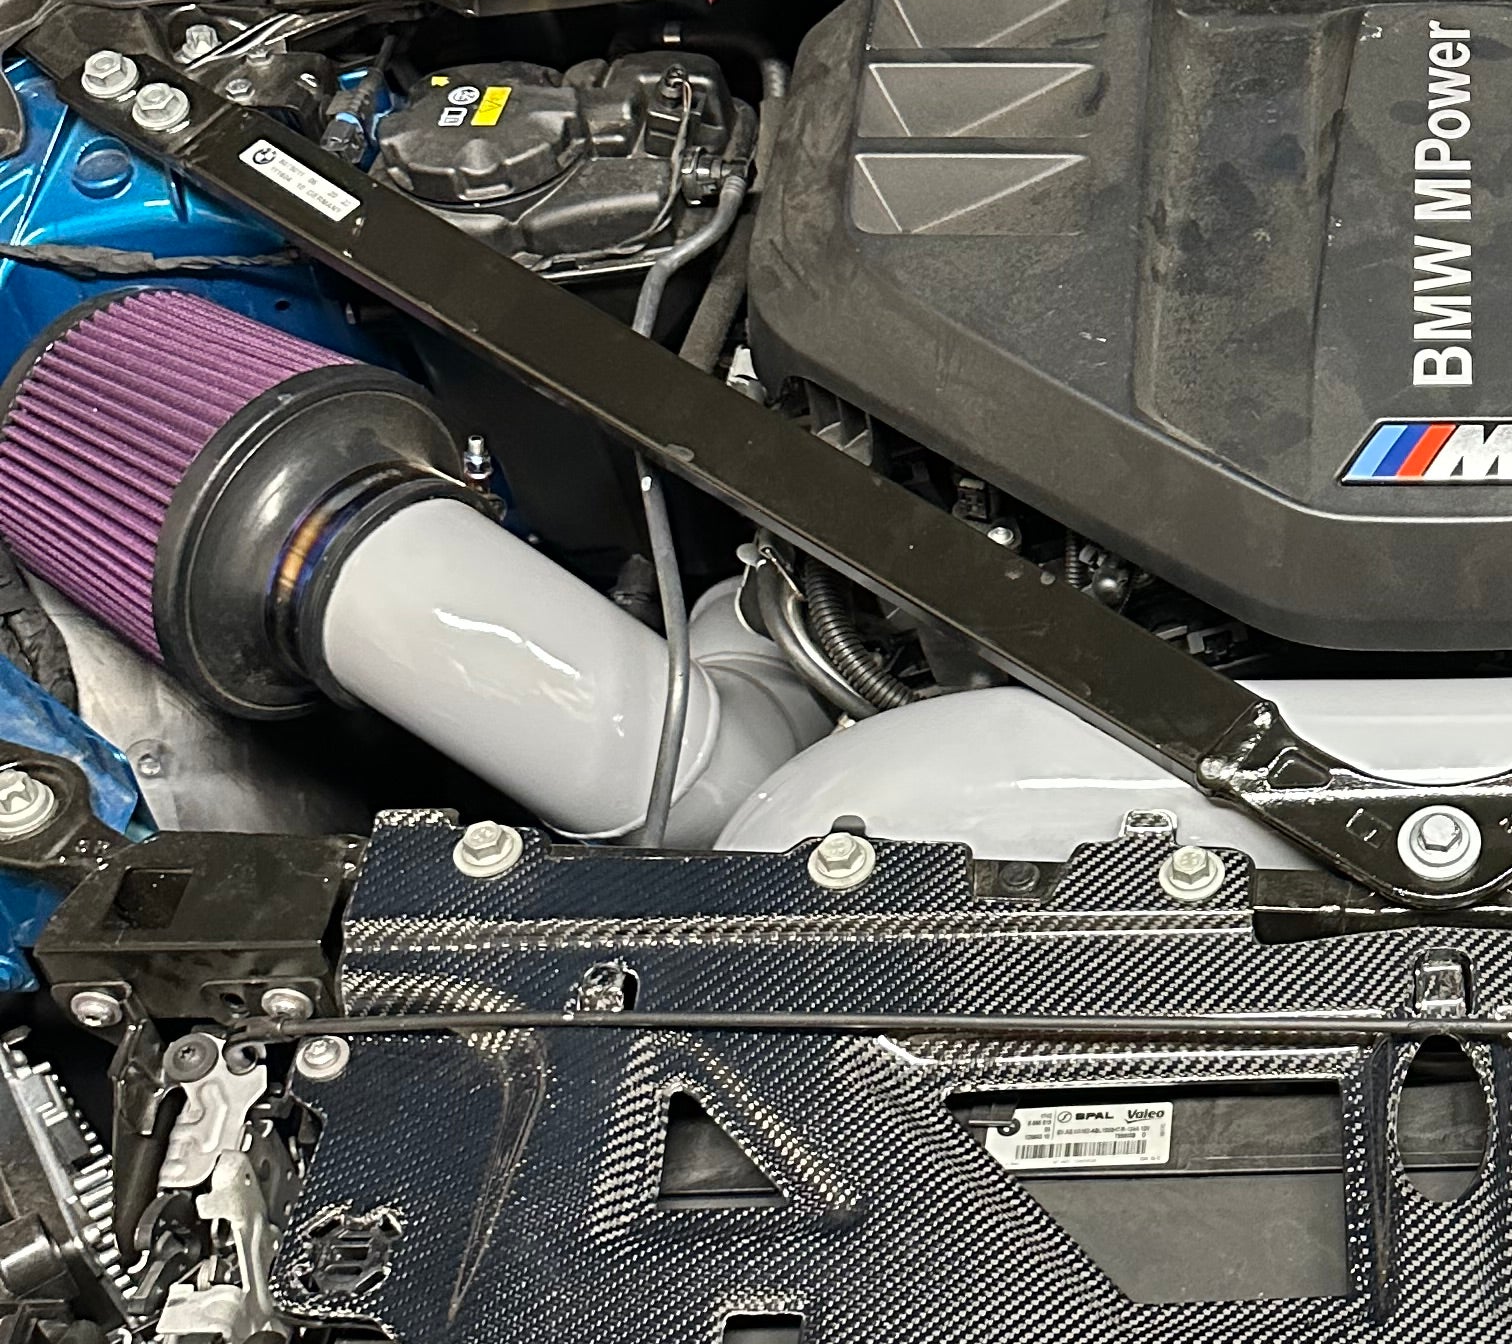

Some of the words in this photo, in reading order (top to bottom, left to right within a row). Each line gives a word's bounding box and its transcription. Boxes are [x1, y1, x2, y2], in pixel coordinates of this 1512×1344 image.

[1414, 19, 1472, 221] MPower
[1413, 235, 1473, 386] BMW
[1075, 1111, 1114, 1121] SPAL
[1127, 1108, 1165, 1120] Valeo
